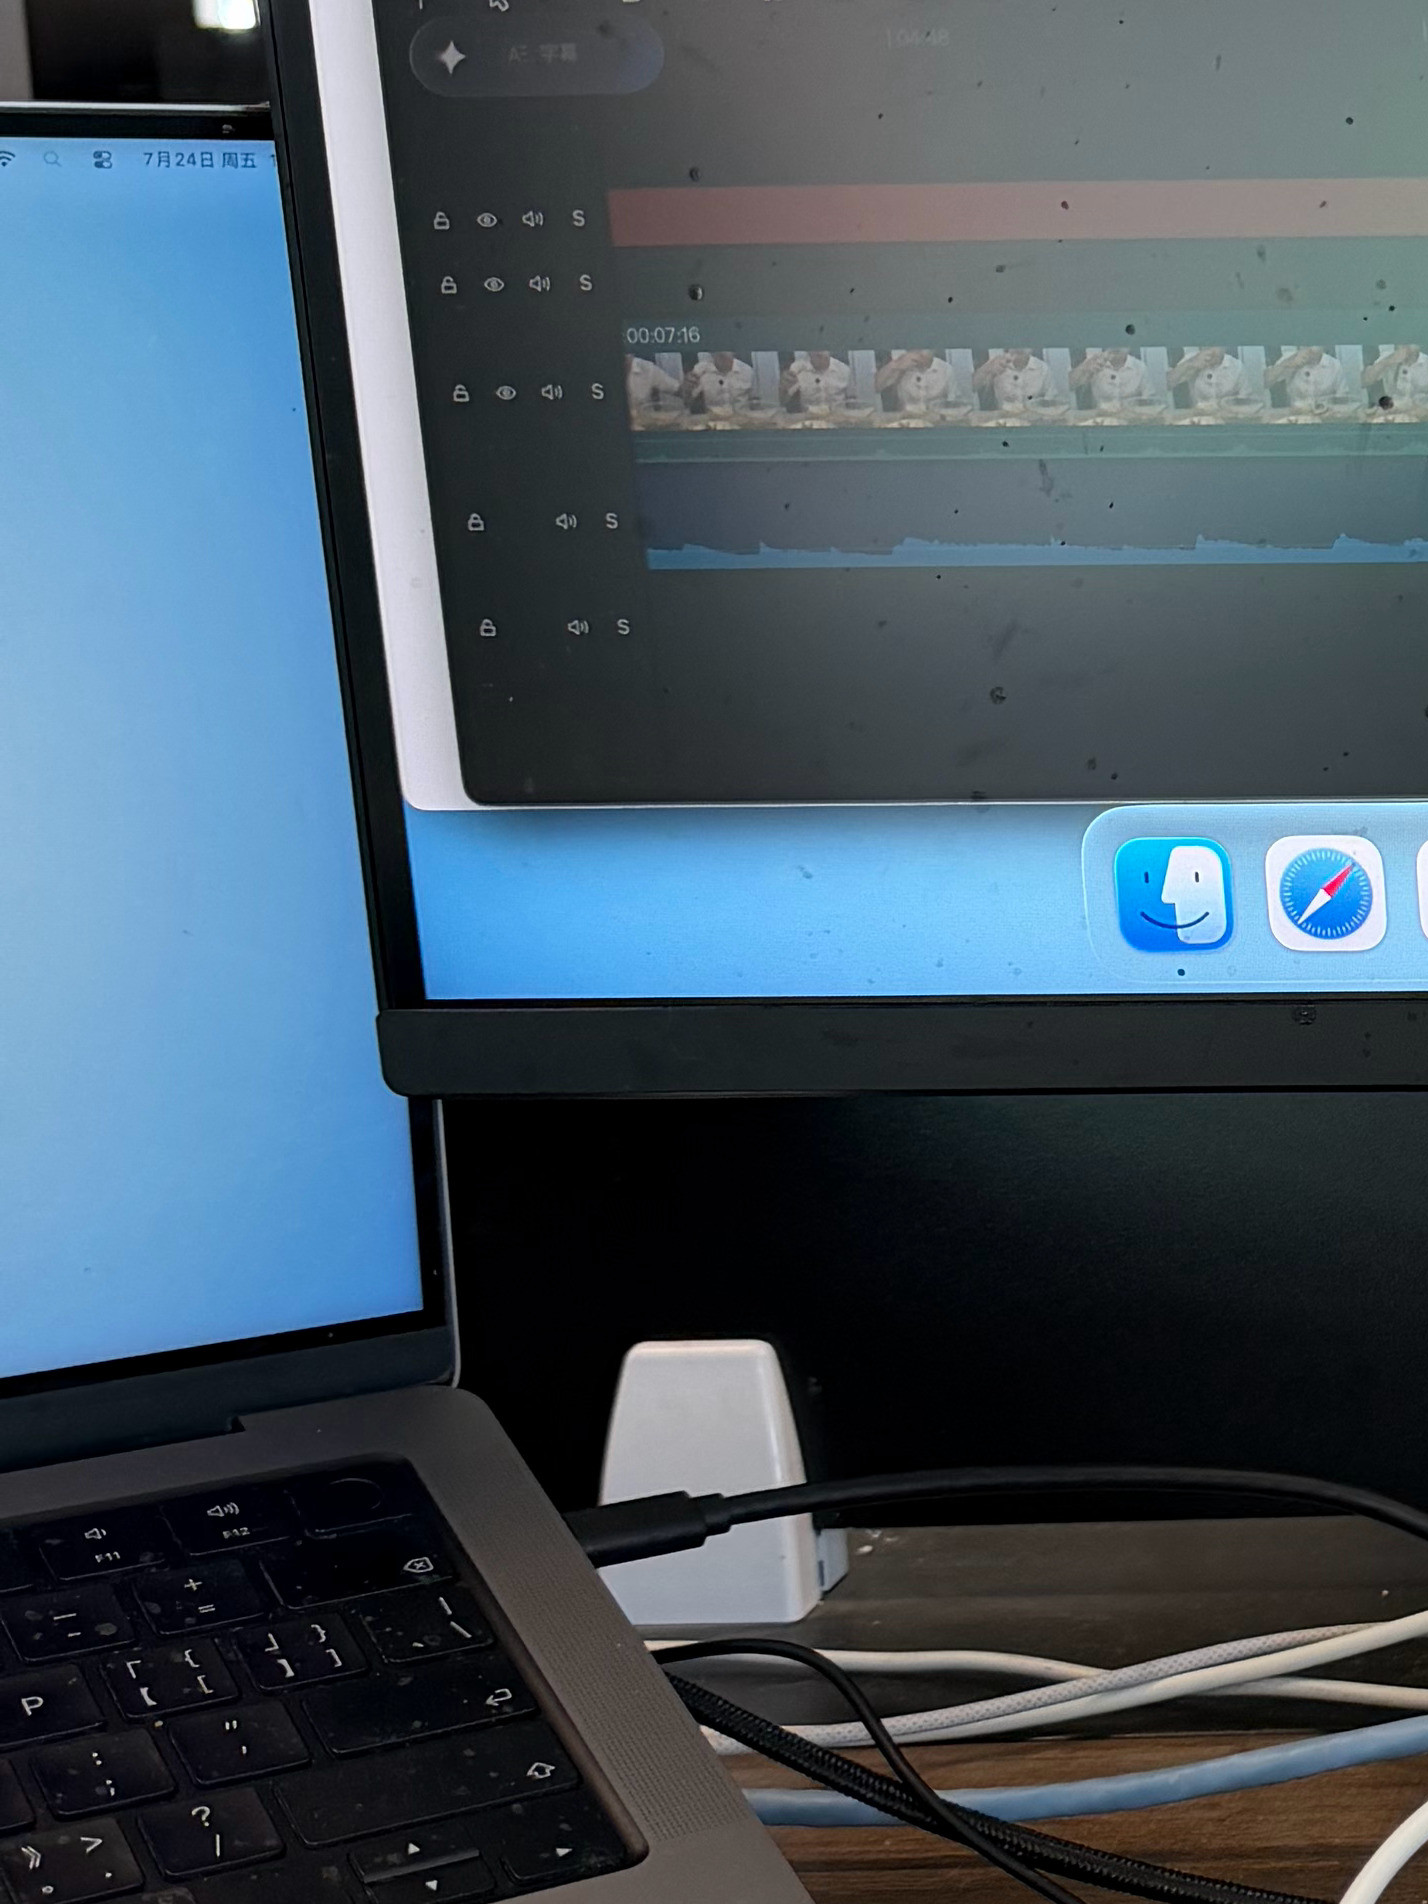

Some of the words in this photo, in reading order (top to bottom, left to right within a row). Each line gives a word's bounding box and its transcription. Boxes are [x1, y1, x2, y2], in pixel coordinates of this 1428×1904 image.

[143, 152, 215, 168] 7月24日
[221, 152, 257, 169] 周五
[21, 1695, 44, 1717] P
